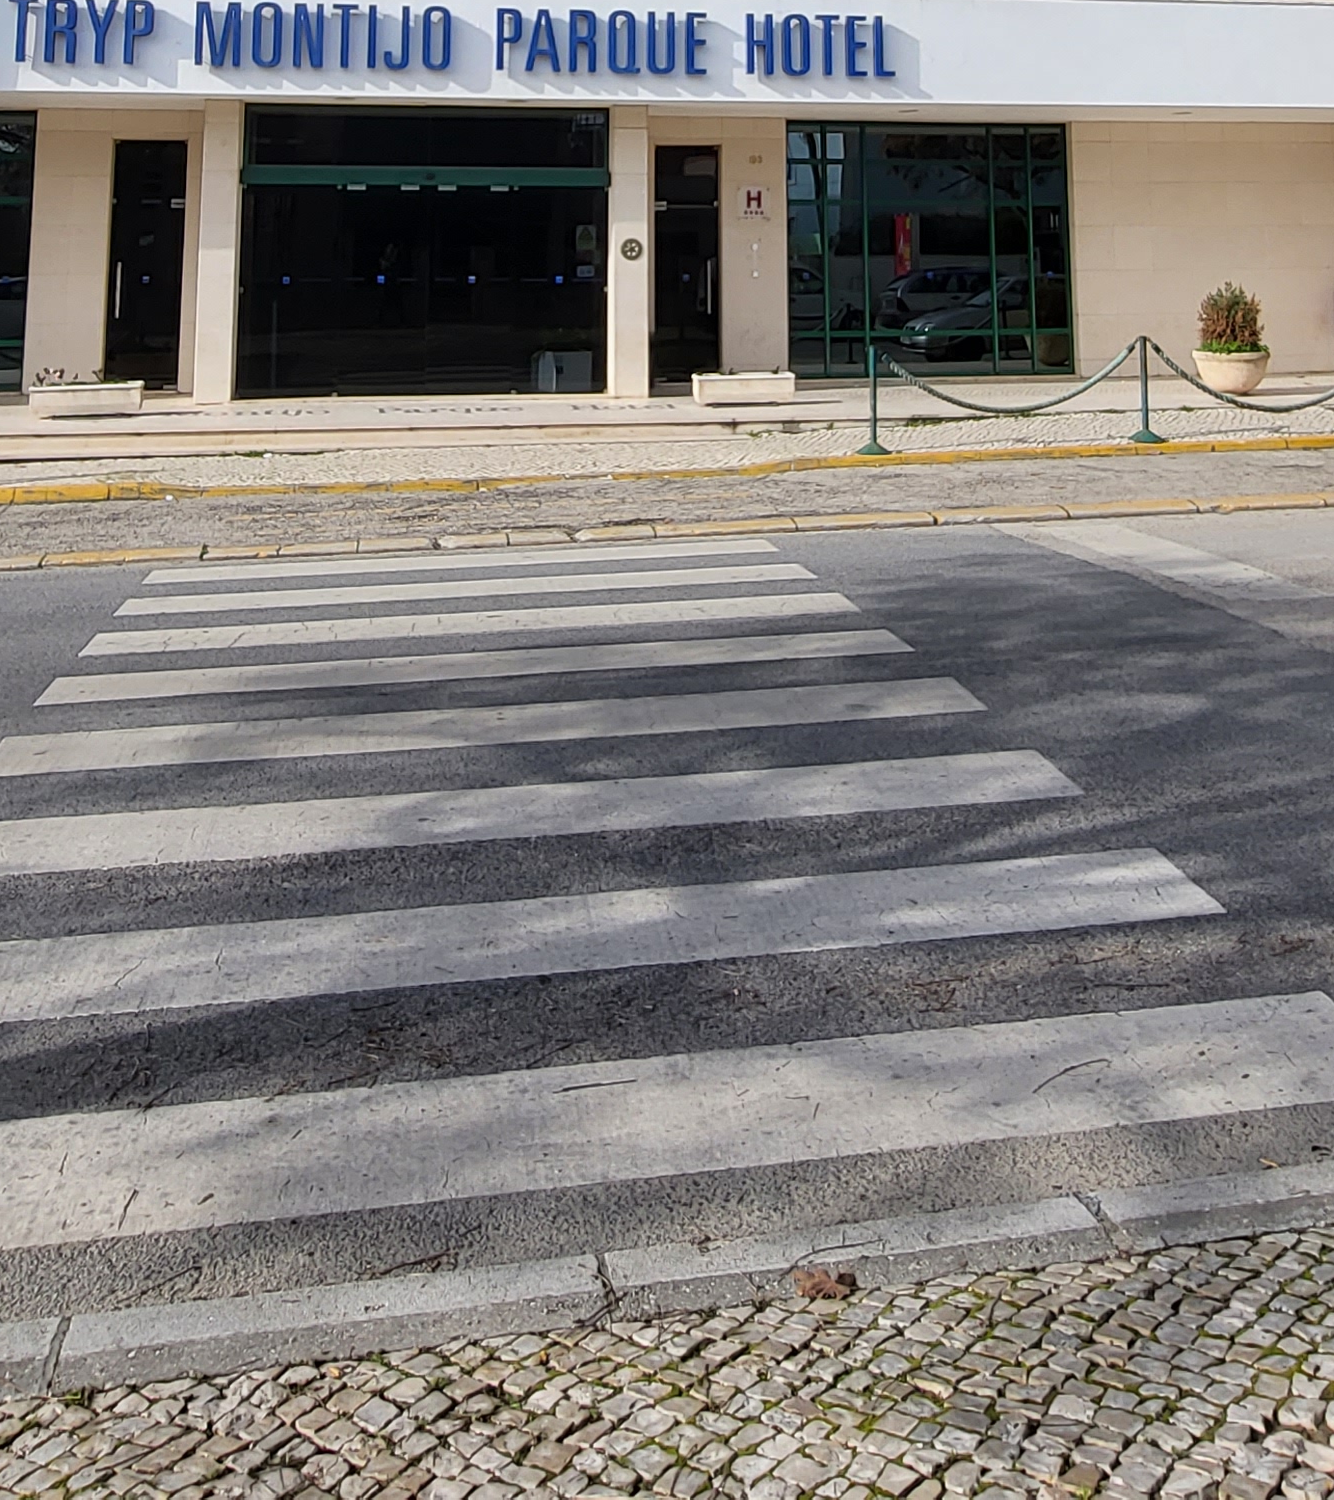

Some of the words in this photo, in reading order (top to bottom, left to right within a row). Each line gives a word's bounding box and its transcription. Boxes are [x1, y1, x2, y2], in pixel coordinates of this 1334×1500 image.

[194, 1, 451, 72] MONTIJO
[496, 7, 707, 76] PARQUE
[745, 13, 896, 78] HOTEL
[746, 190, 762, 209] H
